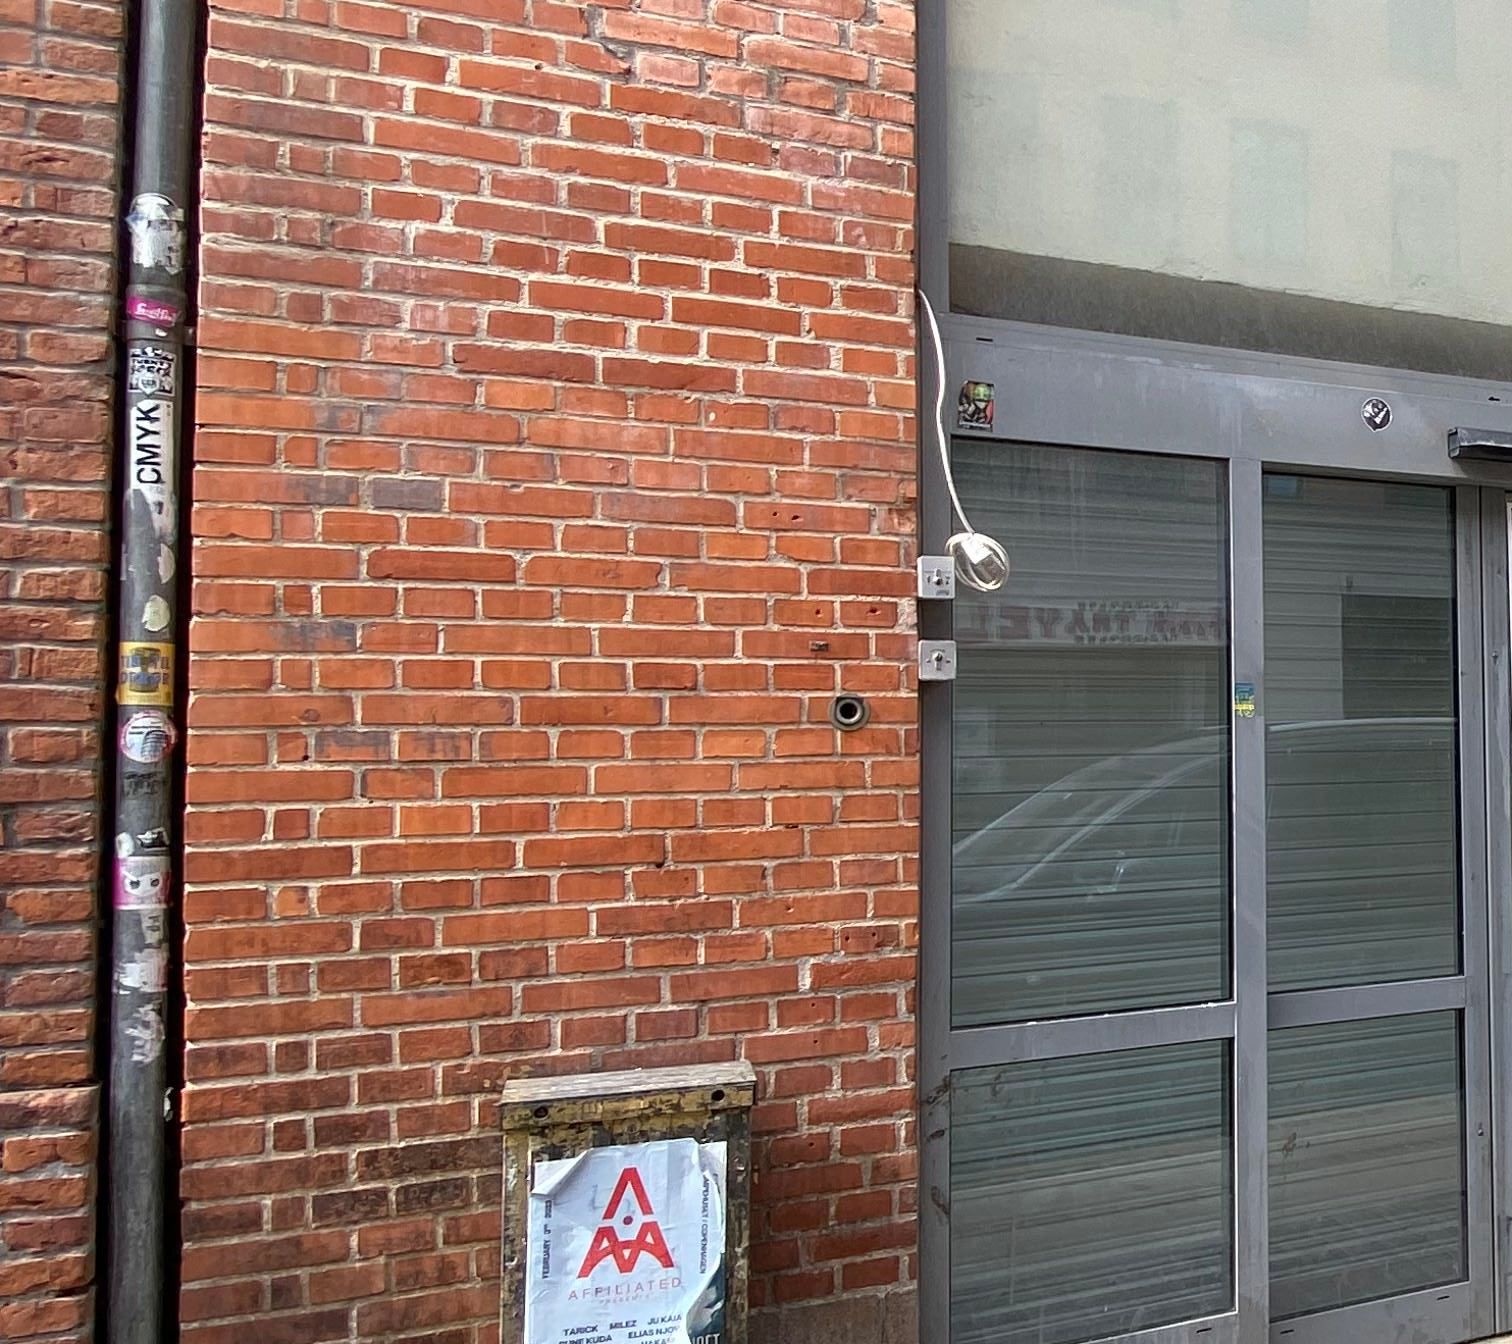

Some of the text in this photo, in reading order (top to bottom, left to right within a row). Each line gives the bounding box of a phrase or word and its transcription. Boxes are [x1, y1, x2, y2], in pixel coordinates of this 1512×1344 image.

[136, 404, 163, 484] CMYK
[542, 1239, 552, 1279] FEBRUARY
[699, 1224, 708, 1274] COPENHAGEN
[568, 1277, 681, 1301] AFFILIATED
[563, 1325, 598, 1336] TARICK
[609, 1320, 637, 1330] MILEZ
[585, 1335, 612, 1344] KUDA
[628, 1330, 654, 1339] ELIAS
